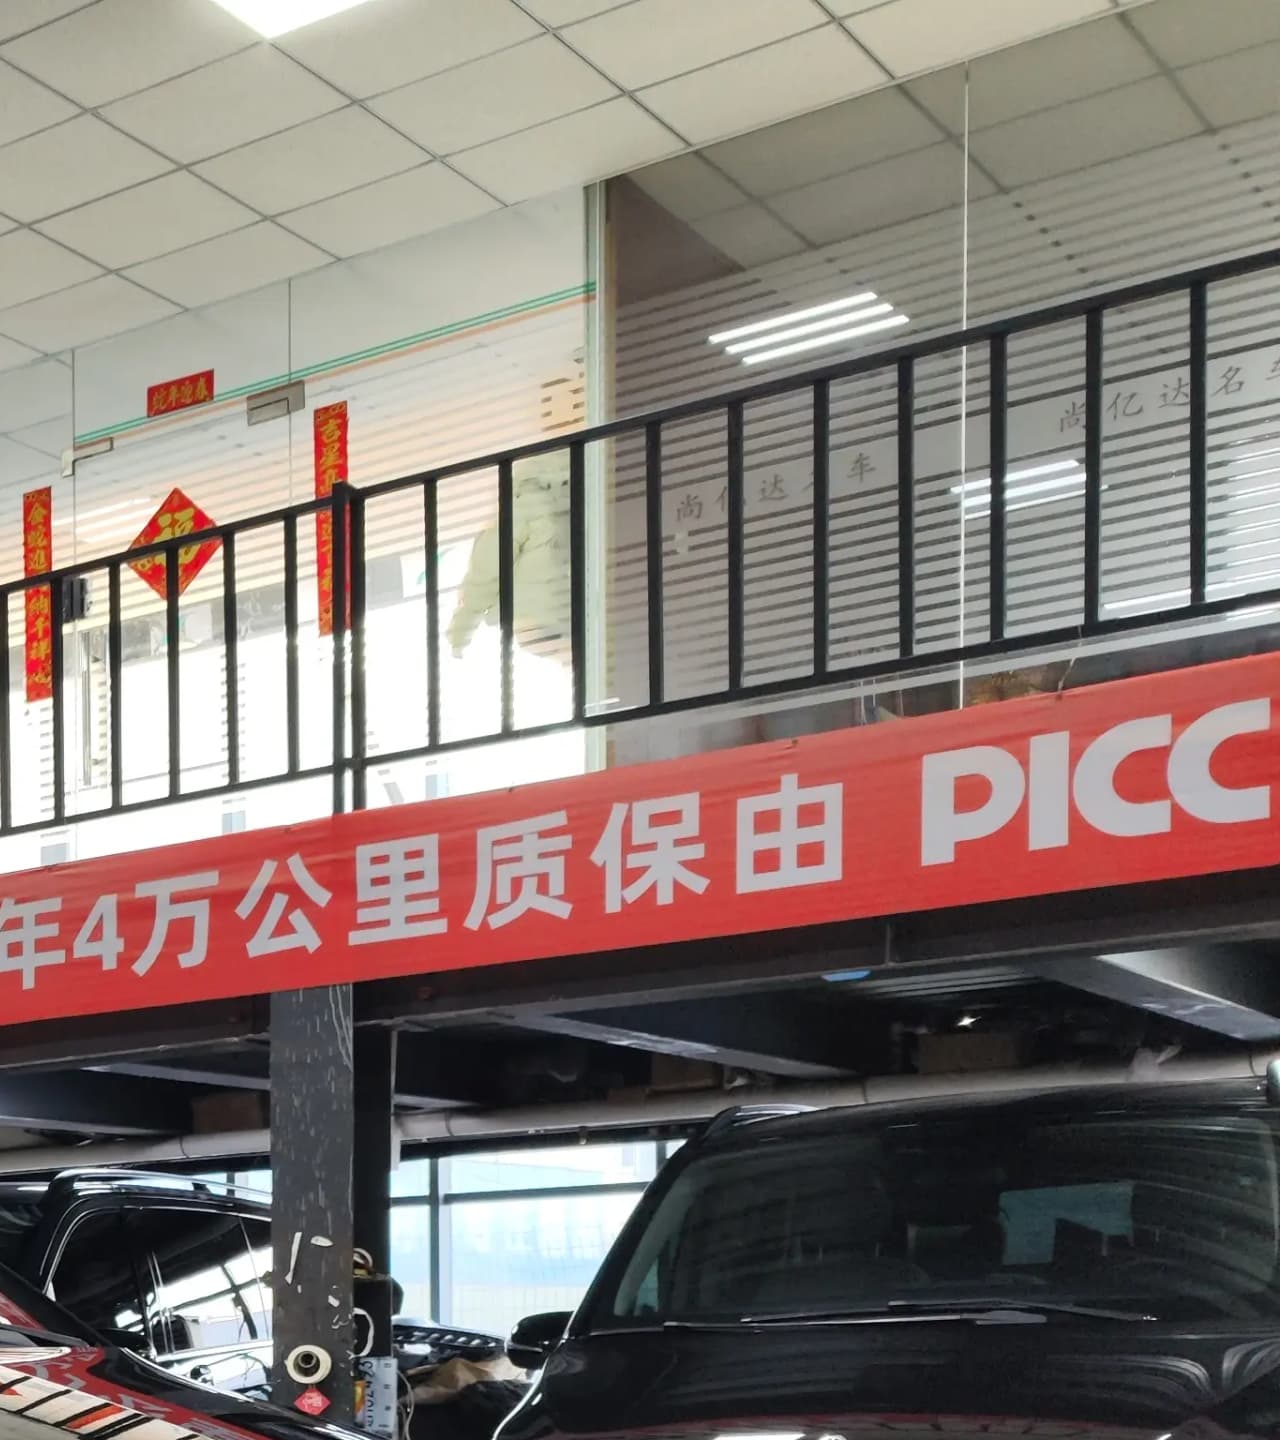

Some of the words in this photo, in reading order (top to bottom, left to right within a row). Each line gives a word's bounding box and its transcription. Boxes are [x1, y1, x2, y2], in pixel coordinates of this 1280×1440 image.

[676, 451, 877, 522] 尚达车
[920, 696, 1271, 867] PICC
